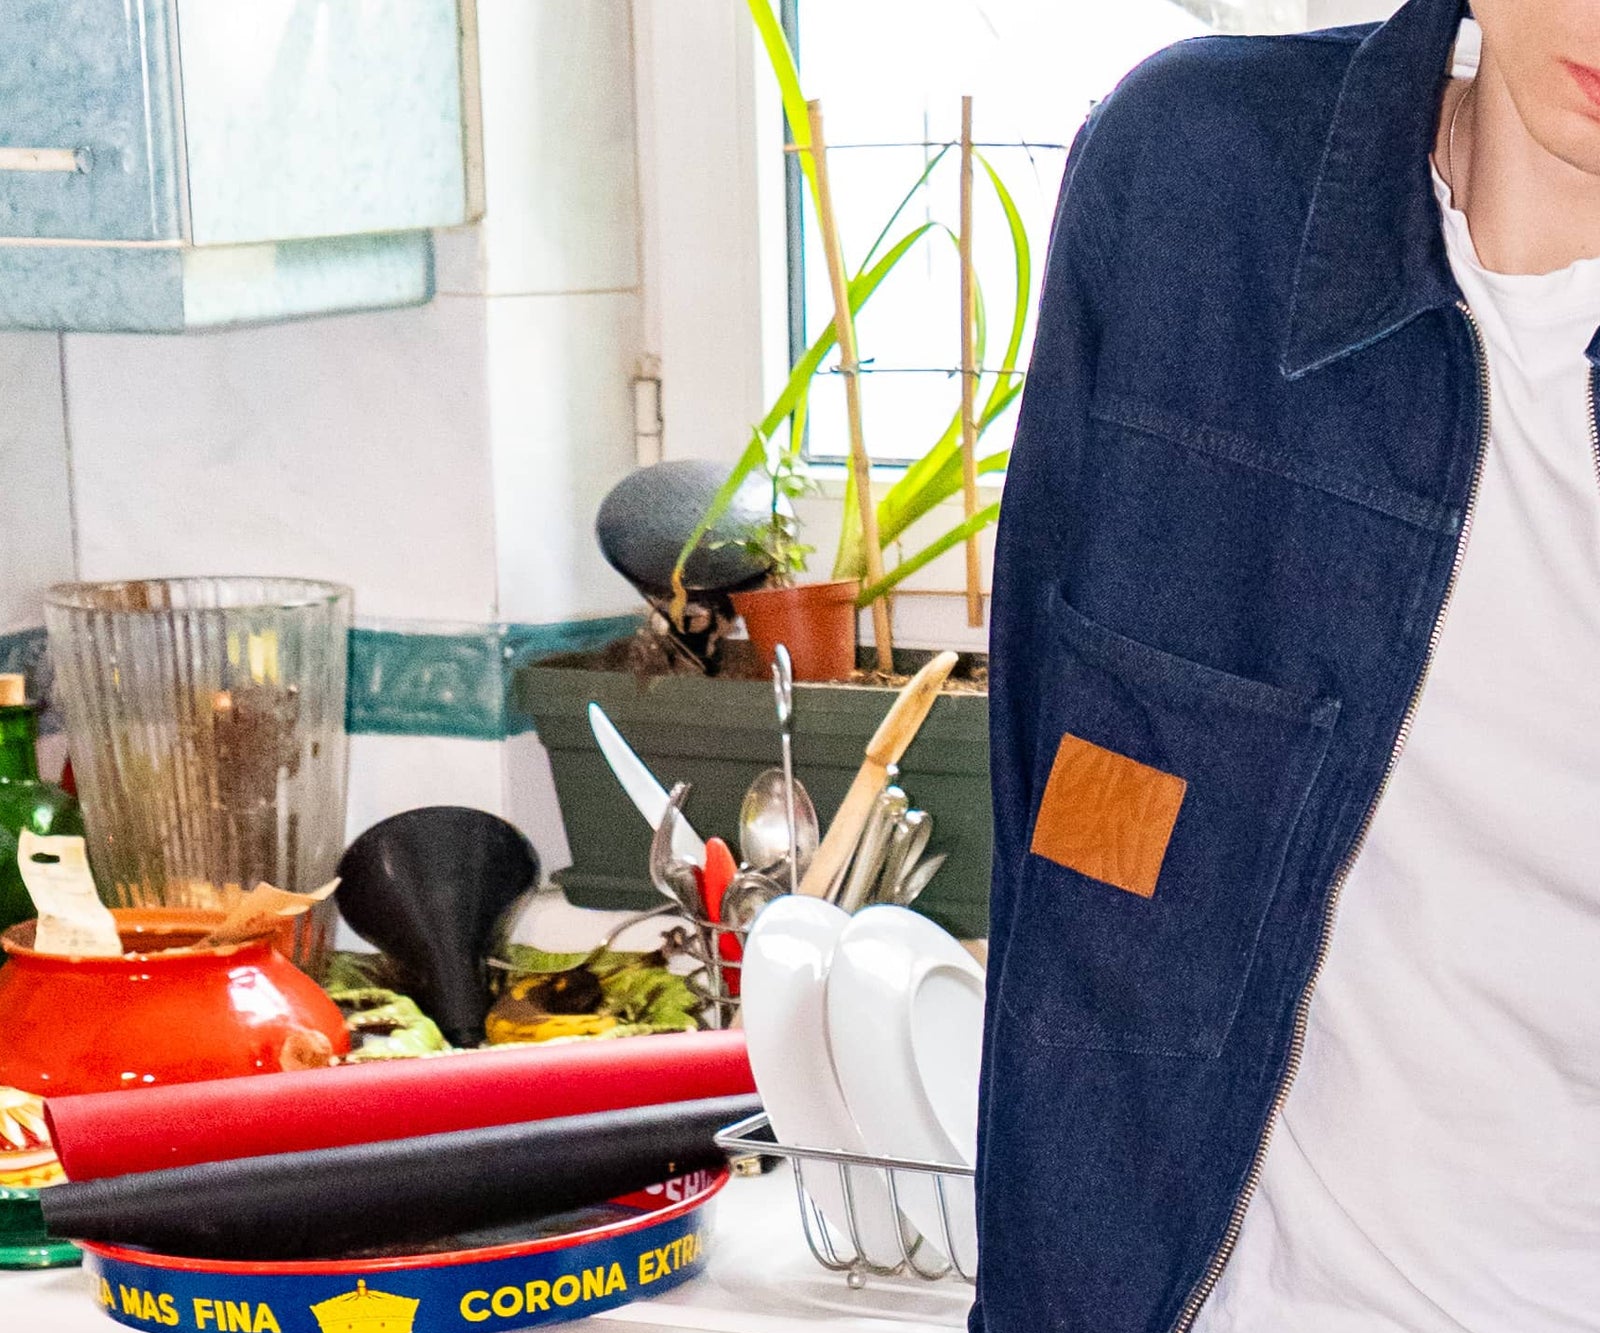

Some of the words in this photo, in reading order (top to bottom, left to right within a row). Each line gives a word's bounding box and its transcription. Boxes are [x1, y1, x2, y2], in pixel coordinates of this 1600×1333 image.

[119, 1284, 180, 1326] MAS
[460, 1262, 628, 1322] CORONA
[638, 1233, 703, 1285] EXTRA
